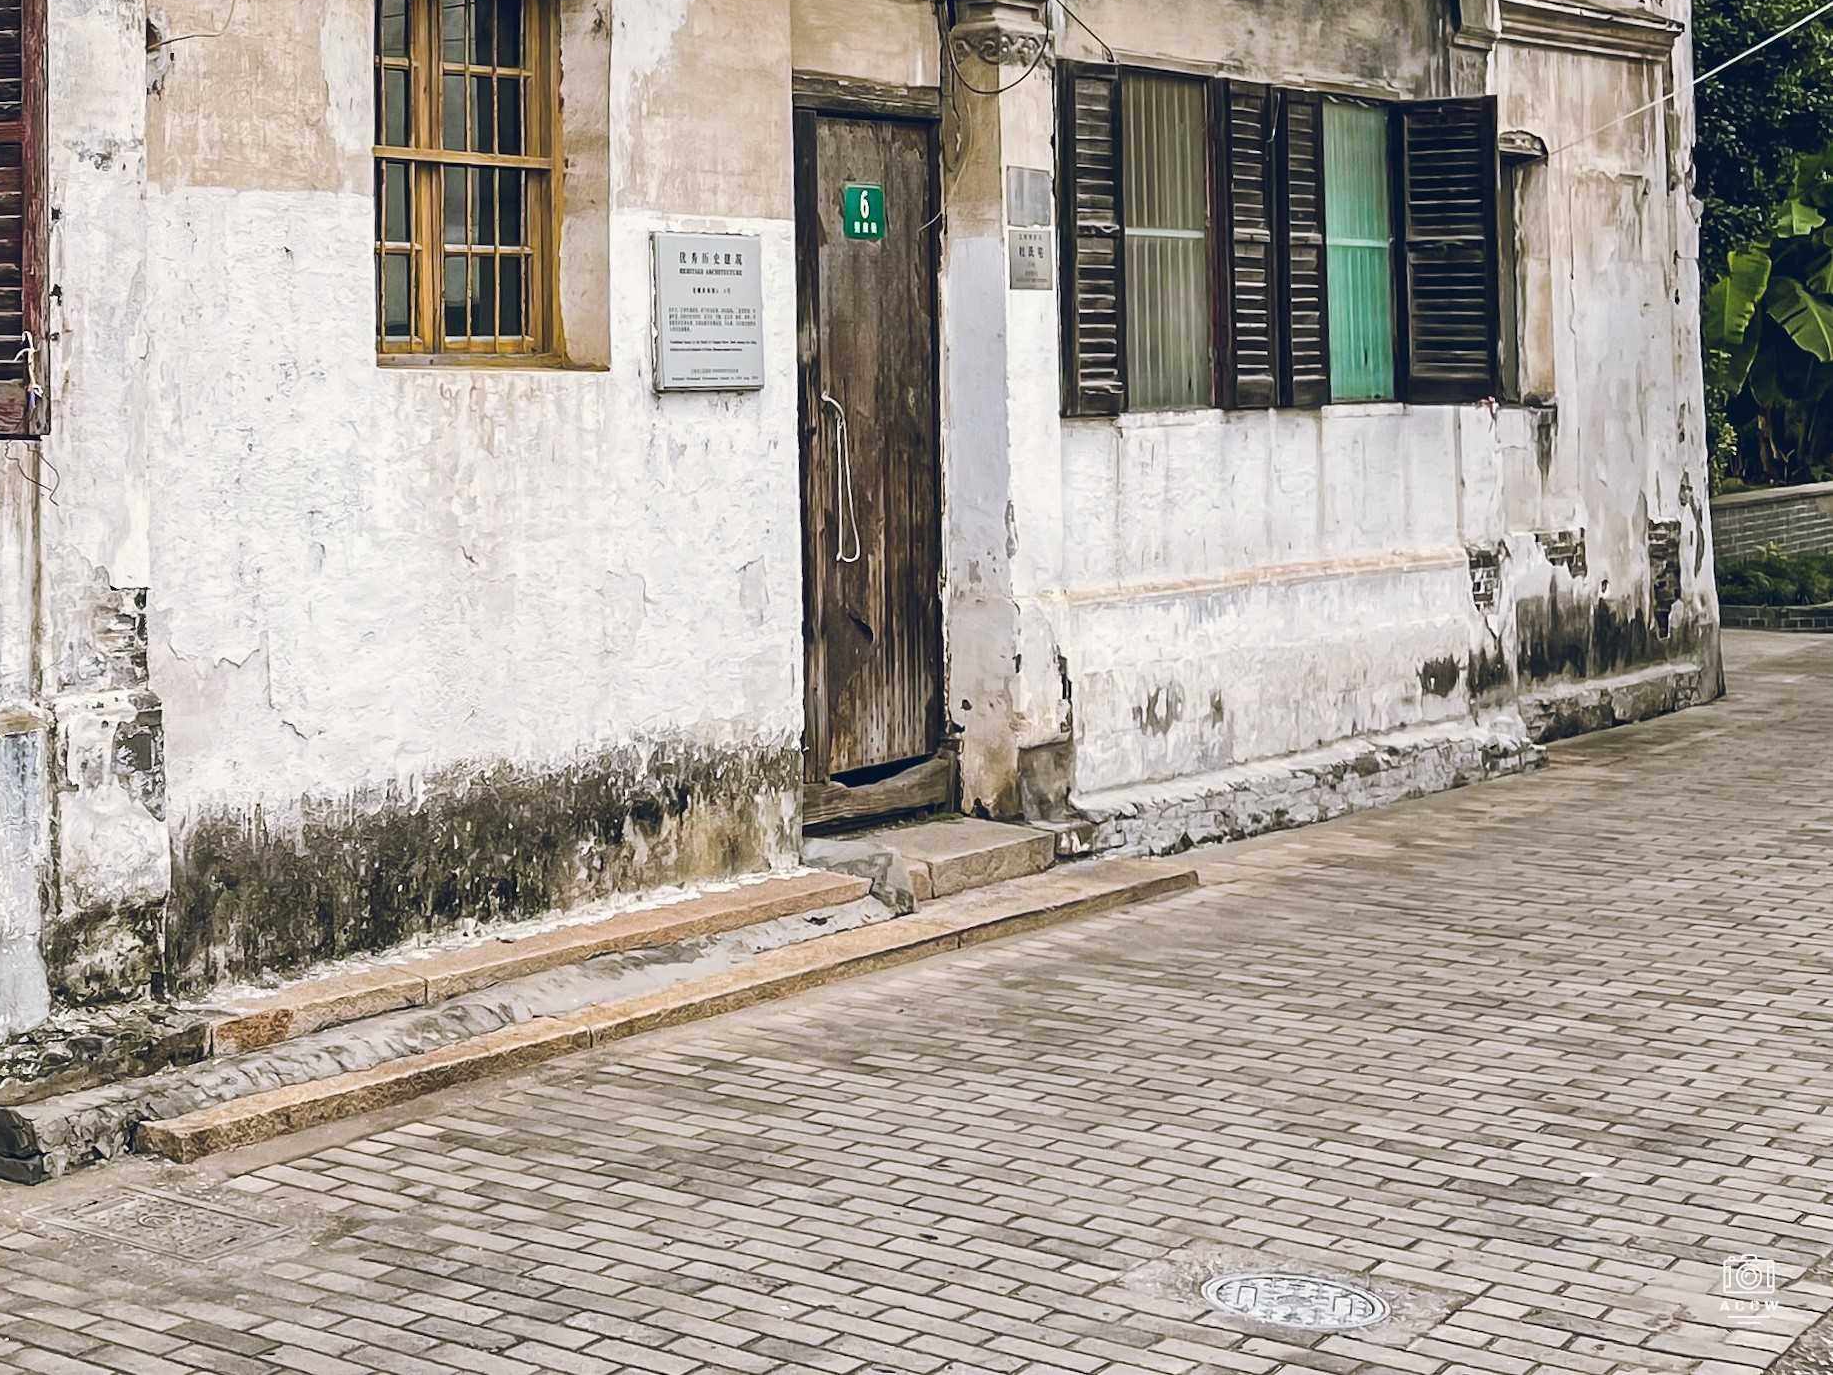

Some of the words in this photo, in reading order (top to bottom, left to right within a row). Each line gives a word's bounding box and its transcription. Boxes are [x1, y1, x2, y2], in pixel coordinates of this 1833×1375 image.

[860, 190, 870, 219] 6
[679, 251, 743, 266] 优秀历史建筑
